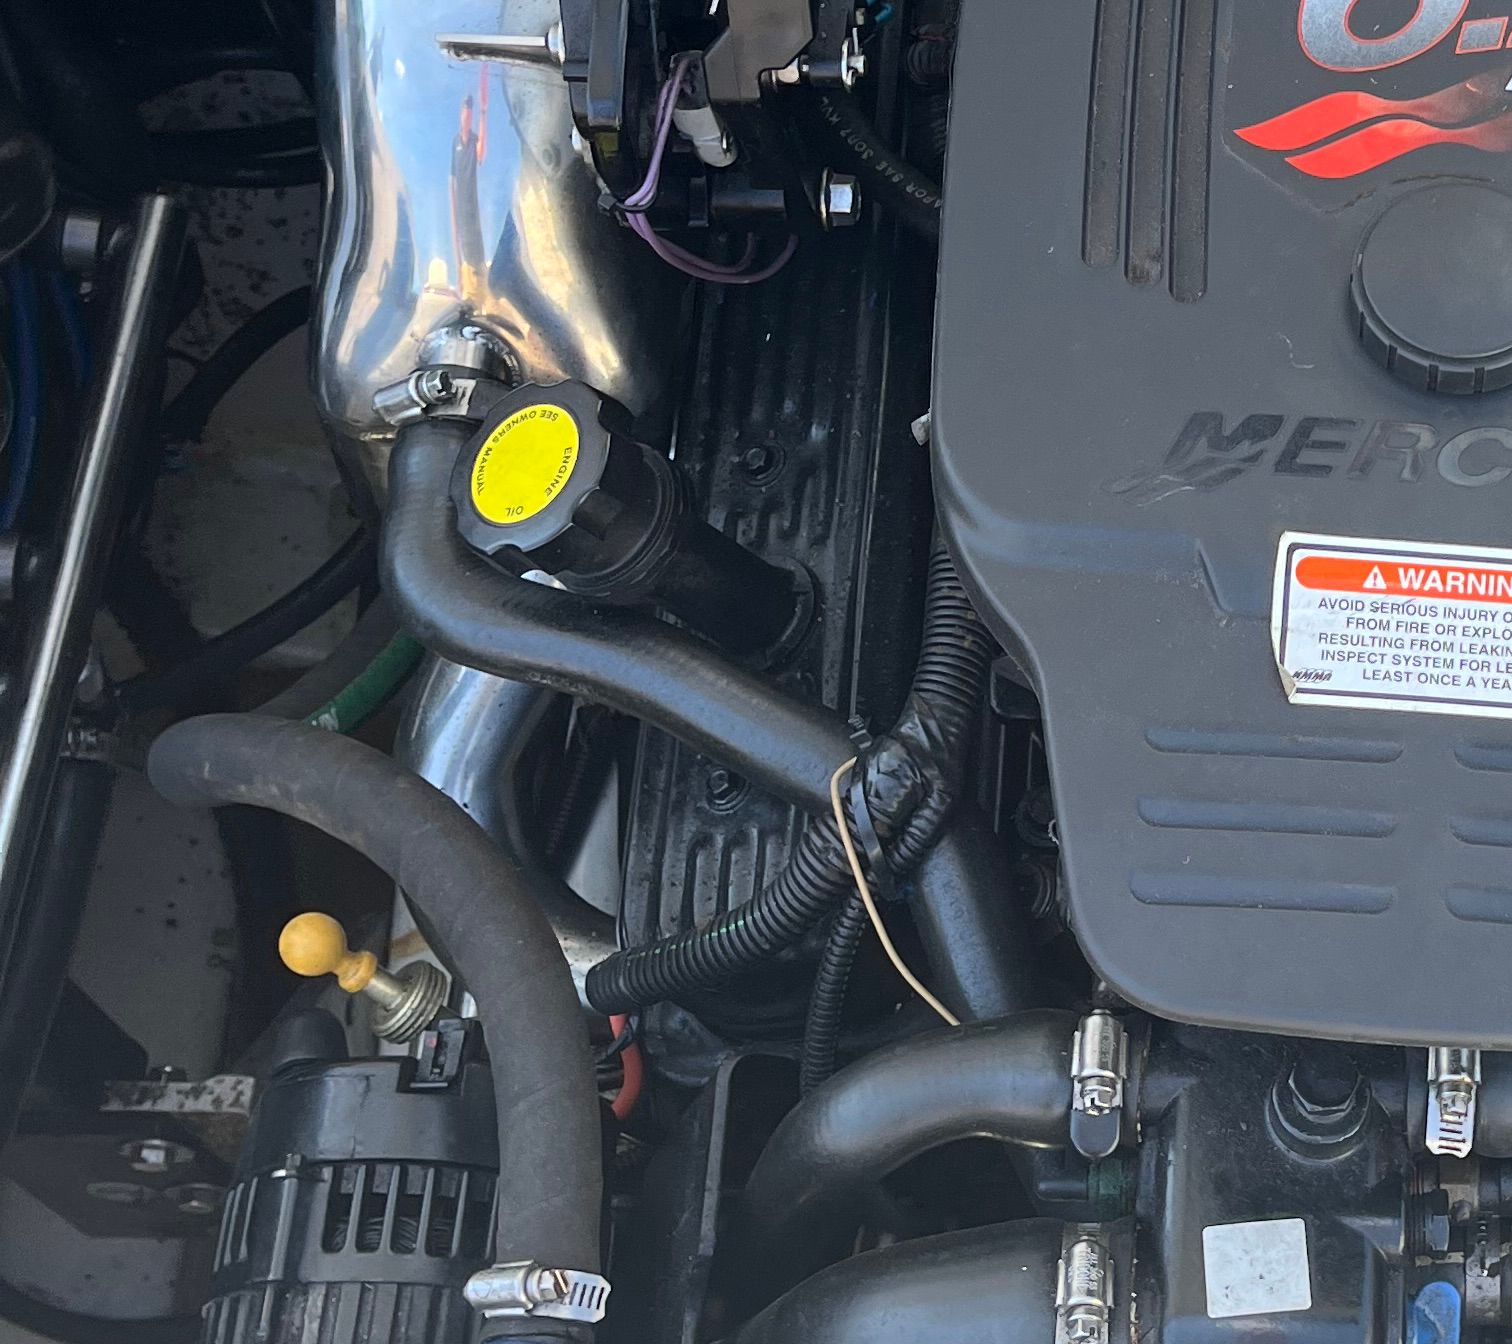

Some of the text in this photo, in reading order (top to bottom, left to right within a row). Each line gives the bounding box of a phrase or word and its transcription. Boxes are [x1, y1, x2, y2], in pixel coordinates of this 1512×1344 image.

[540, 410, 558, 422] SEE
[476, 447, 493, 497] MANUAL
[505, 446, 573, 517] ENGINE OIL
[1318, 597, 1365, 613] AVOID
[1369, 601, 1438, 617] SERIOUS
[1443, 606, 1498, 622] INJURY
[1346, 616, 1390, 631] FROM
[1395, 619, 1430, 634] FIRE
[1434, 623, 1456, 637] OR
[1318, 632, 1405, 649] RESULTING
[1410, 638, 1454, 653] FROM
[1320, 649, 1387, 665] INSPECT
[1391, 654, 1454, 670] SYSTEM
[1459, 658, 1491, 672] FOR
[1362, 668, 1413, 683] LEAST
[1417, 672, 1461, 687] ONCE
[1466, 676, 1476, 688] A
